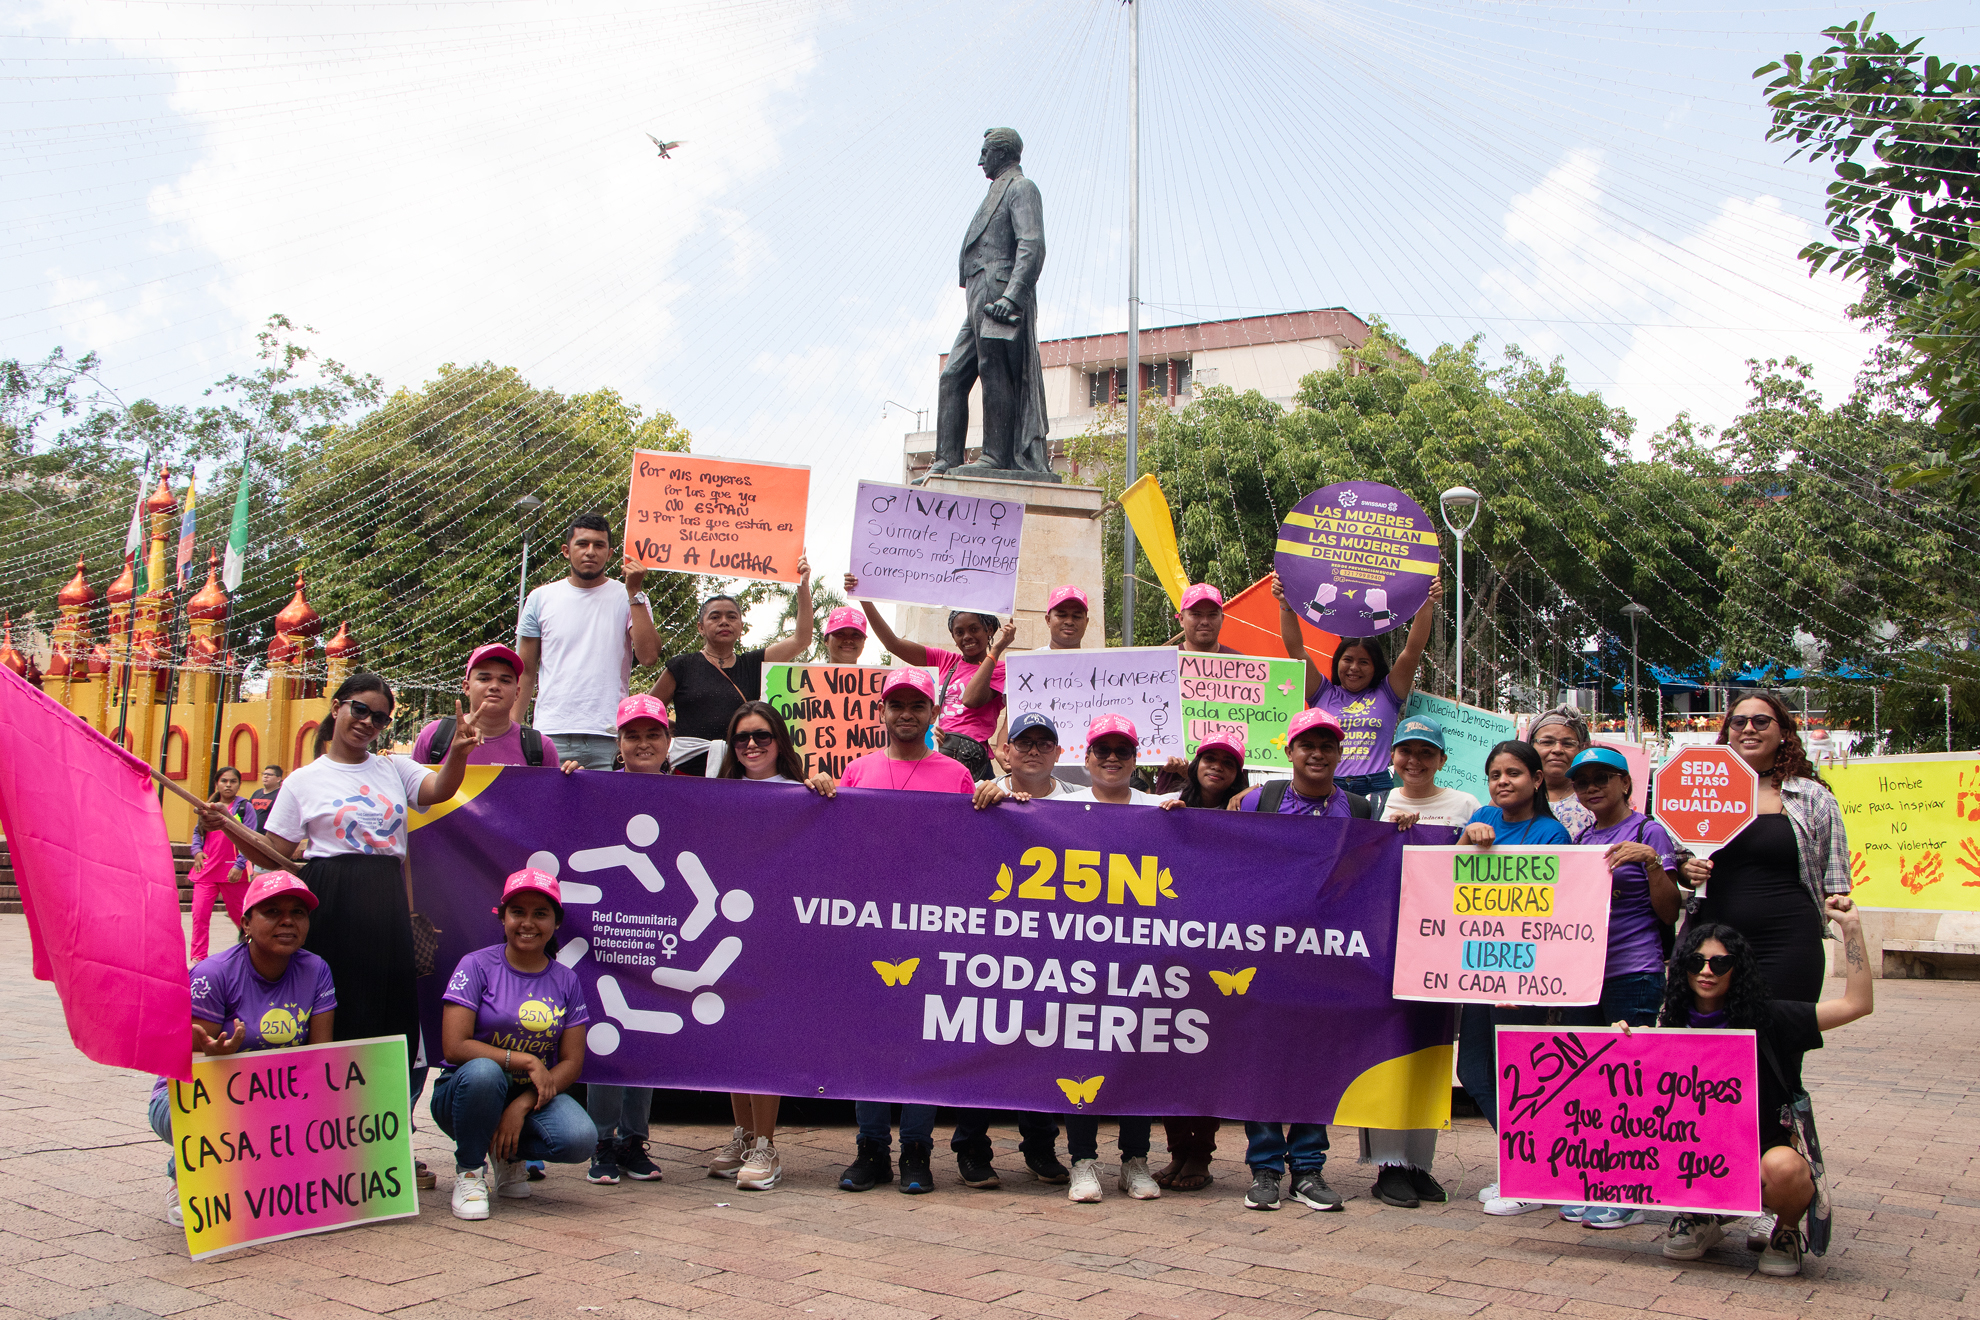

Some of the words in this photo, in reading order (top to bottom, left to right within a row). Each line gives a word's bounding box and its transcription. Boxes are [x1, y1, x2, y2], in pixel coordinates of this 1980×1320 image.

[640, 461, 665, 477] Por
[664, 484, 682, 496] Por
[685, 486, 705, 498] las
[711, 491, 731, 503] que
[738, 492, 757, 506] ya
[666, 499, 684, 511] NO
[653, 512, 675, 523] Por
[680, 515, 700, 526] las
[706, 520, 729, 531] que
[735, 519, 772, 531] están
[777, 522, 793, 532] en
[1313, 505, 1342, 519] LAS
[1345, 509, 1414, 528] MUJERES
[679, 529, 739, 542] SILENCIO
[868, 519, 938, 542] Súmate
[950, 531, 986, 550] para
[992, 535, 1017, 556] que
[1313, 518, 1332, 531] YA
[1336, 522, 1358, 534] NO
[1362, 525, 1422, 542] CALLAN
[1308, 532, 1337, 546] LAS
[1340, 536, 1410, 556] MUJERES
[684, 546, 700, 565] A
[710, 549, 778, 575] LUCHAR
[931, 550, 955, 565] más
[1312, 547, 1401, 569] DENUNCIAN
[1018, 672, 1034, 692] X
[1043, 672, 1083, 689] más
[1090, 667, 1177, 690] HOMBRES
[1180, 657, 1266, 680] Mujeres
[787, 668, 815, 693] LA
[824, 668, 886, 696] VIOLE
[1181, 679, 1260, 704] Seguras
[844, 697, 863, 721] LA
[1182, 701, 1219, 719] ada
[1228, 707, 1288, 724] espacio
[1461, 710, 1509, 734] Demostrar
[815, 726, 836, 748] ES
[847, 724, 890, 749] NATU
[1467, 733, 1477, 742] no
[1479, 736, 1488, 747] te
[1244, 748, 1278, 760] aso.
[1681, 761, 1729, 775] SEDA
[1681, 776, 1693, 786] EL
[1696, 776, 1729, 786] PASO
[1879, 776, 1922, 792] Hombre
[1691, 788, 1700, 797] A
[1702, 789, 1717, 798] LA
[1662, 799, 1747, 814] IGUALDAD
[1899, 800, 1946, 813] inspirar
[1891, 821, 1908, 834] NO
[1897, 838, 1947, 851] violentar
[1018, 846, 1159, 906] 25N
[1455, 855, 1555, 882] MUJERES
[1456, 886, 1550, 913] SEGURAS
[592, 911, 612, 922] Red
[615, 912, 678, 926] Comunitaria
[793, 896, 884, 930] VIDA
[891, 903, 987, 934] LIBRE
[994, 910, 1040, 938] DE
[1047, 912, 1266, 951] VIOLENCIAS
[1274, 925, 1372, 959] PARA
[604, 925, 656, 938] Prevención
[658, 931, 664, 940] y
[1420, 919, 1446, 936] EN
[1459, 920, 1505, 937] CADA
[1522, 922, 1595, 943] ESPACIO,
[593, 937, 643, 949] Detección
[645, 941, 655, 950] de
[1466, 941, 1535, 969] LIBRES
[594, 950, 656, 966] Violencias
[938, 951, 1097, 996] TODAS
[1107, 962, 1192, 1000] LAS
[1423, 972, 1448, 990] EN
[1458, 974, 1506, 994] CADA
[1518, 974, 1567, 996] PASO.
[262, 1019, 294, 1034] 25N
[520, 1008, 549, 1023] 25N
[922, 994, 1211, 1055] MUJERES
[174, 1077, 211, 1114] LA
[226, 1063, 309, 1106] CALLE,
[325, 1060, 366, 1092] LA
[1599, 1059, 1643, 1097] ni
[1657, 1065, 1742, 1116] golpes
[1564, 1098, 1603, 1136] que
[1611, 1103, 1700, 1143] duelan
[180, 1132, 261, 1172] CASA,
[305, 1111, 399, 1154] COLEGIO
[1502, 1130, 1536, 1164] ni
[1677, 1151, 1730, 1189] que
[1579, 1171, 1661, 1203] hieran.
[188, 1193, 232, 1234] SIN
[244, 1166, 401, 1220] VIOLENCIAS
